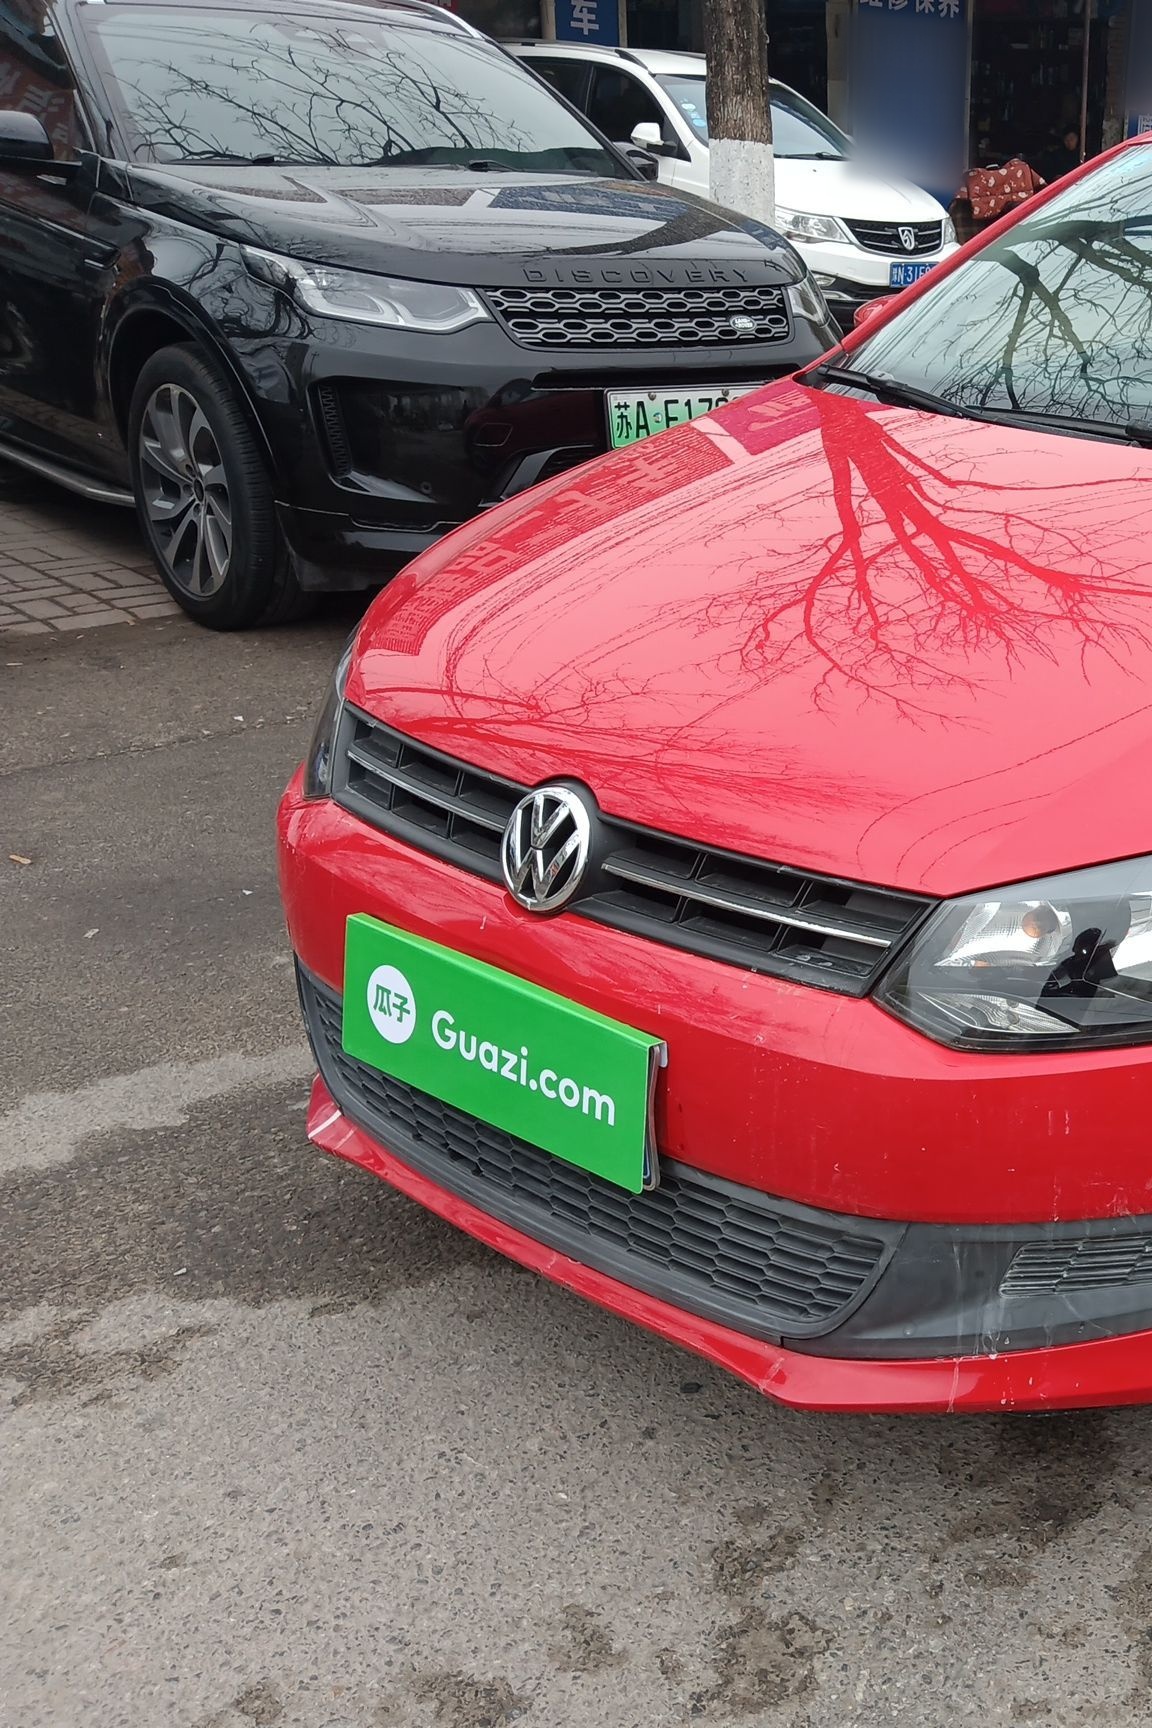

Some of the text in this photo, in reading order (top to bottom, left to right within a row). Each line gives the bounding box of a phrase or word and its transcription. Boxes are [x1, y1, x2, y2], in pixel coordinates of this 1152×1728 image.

[570, 0, 600, 36] 车
[522, 267, 750, 284] DISCOVERY
[373, 983, 411, 1024] 瓜子
[431, 1009, 616, 1127] Guazi.com
